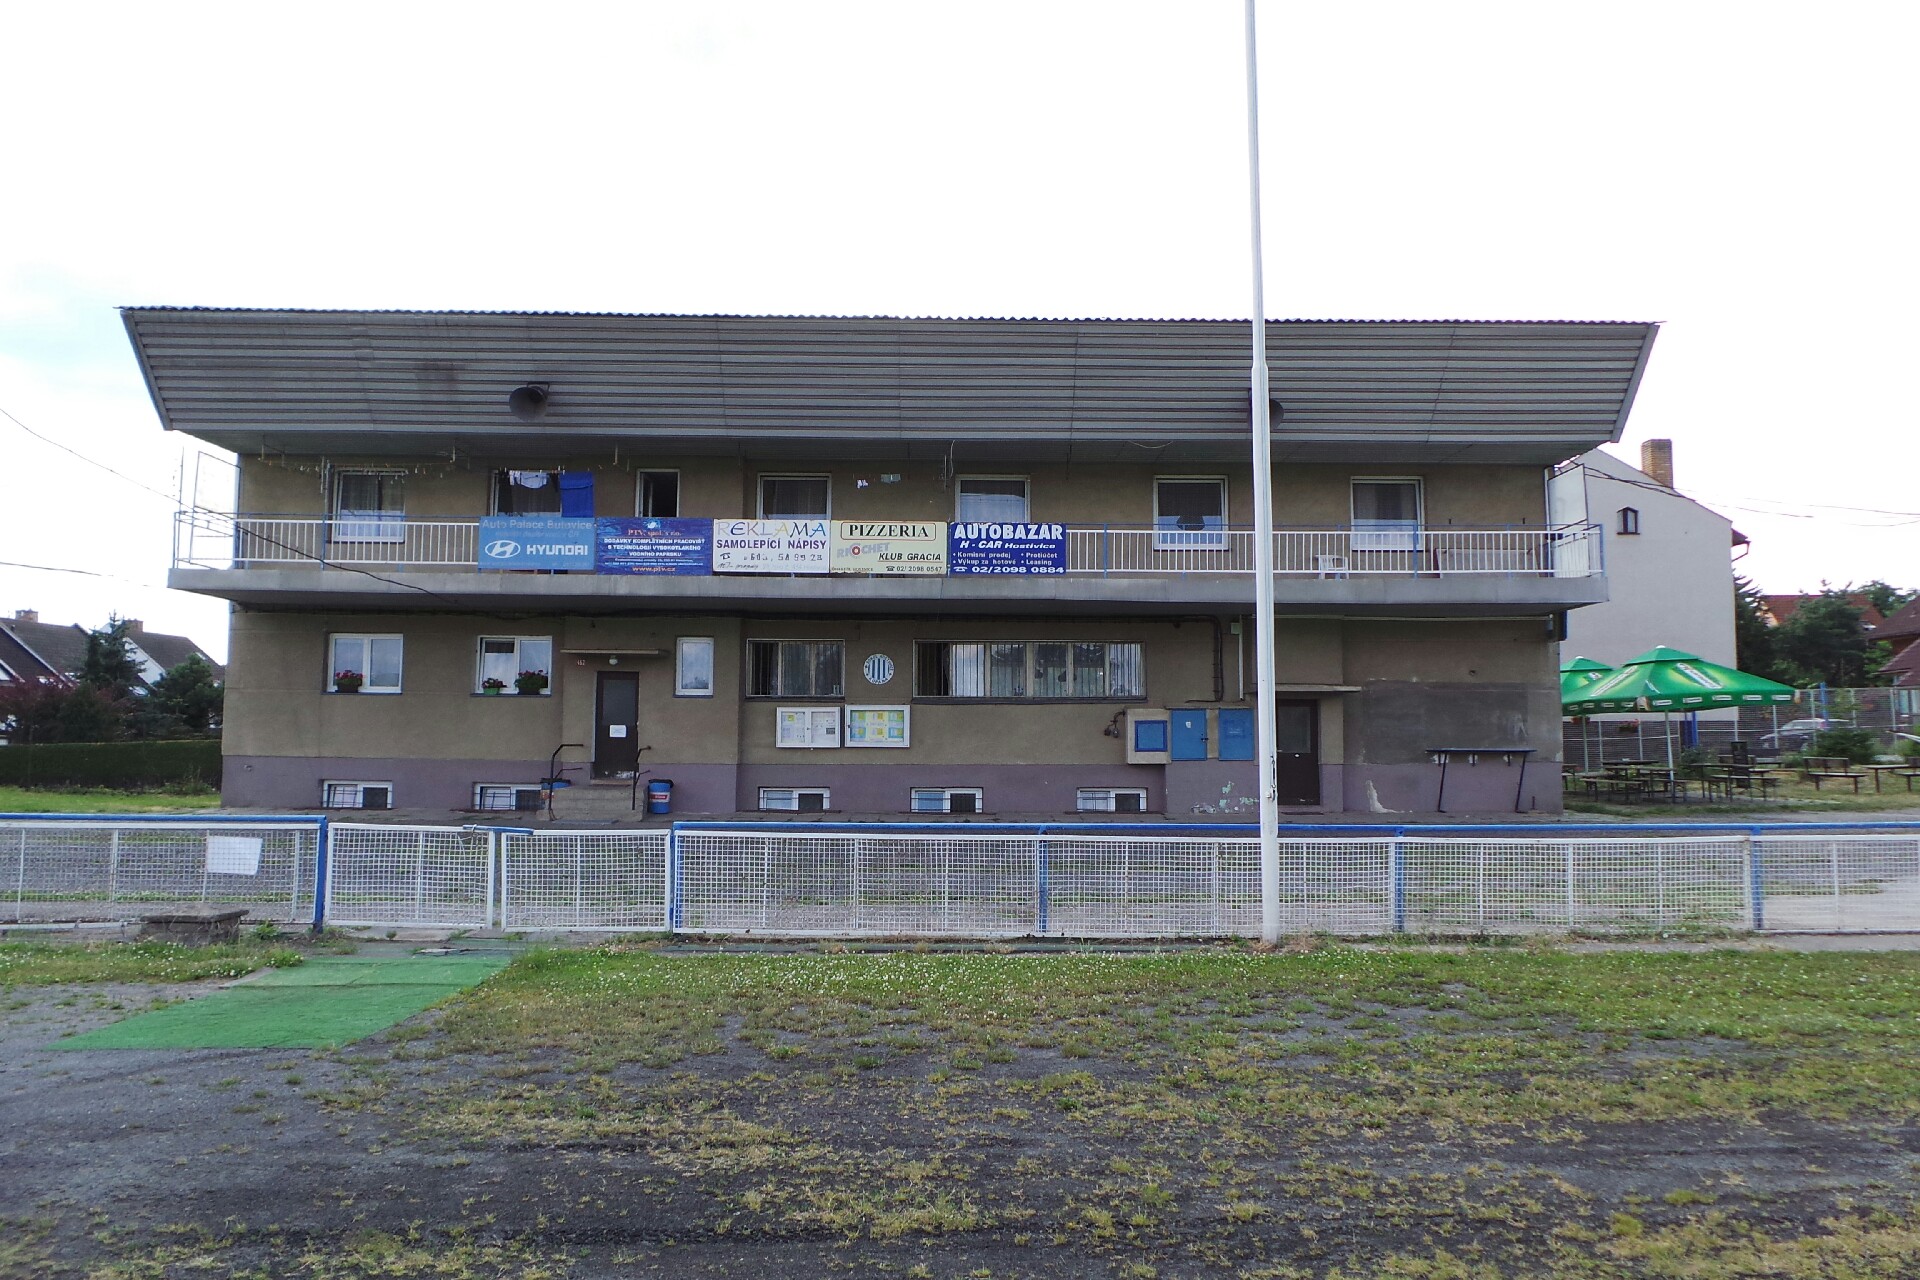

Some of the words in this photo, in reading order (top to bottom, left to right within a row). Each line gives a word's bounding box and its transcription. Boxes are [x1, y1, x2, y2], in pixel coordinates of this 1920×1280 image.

[482, 520, 506, 529] Auto
[510, 520, 544, 529] Palace
[547, 520, 592, 530] Butovice
[716, 521, 826, 538] REKLAMA
[849, 524, 928, 537] PIZZERIA
[954, 524, 1063, 540] AUTOBAZAR
[716, 538, 781, 549] SAMOLEPÍCÍ
[788, 538, 826, 549] NÁPISY
[526, 544, 588, 556] HYUNDAI
